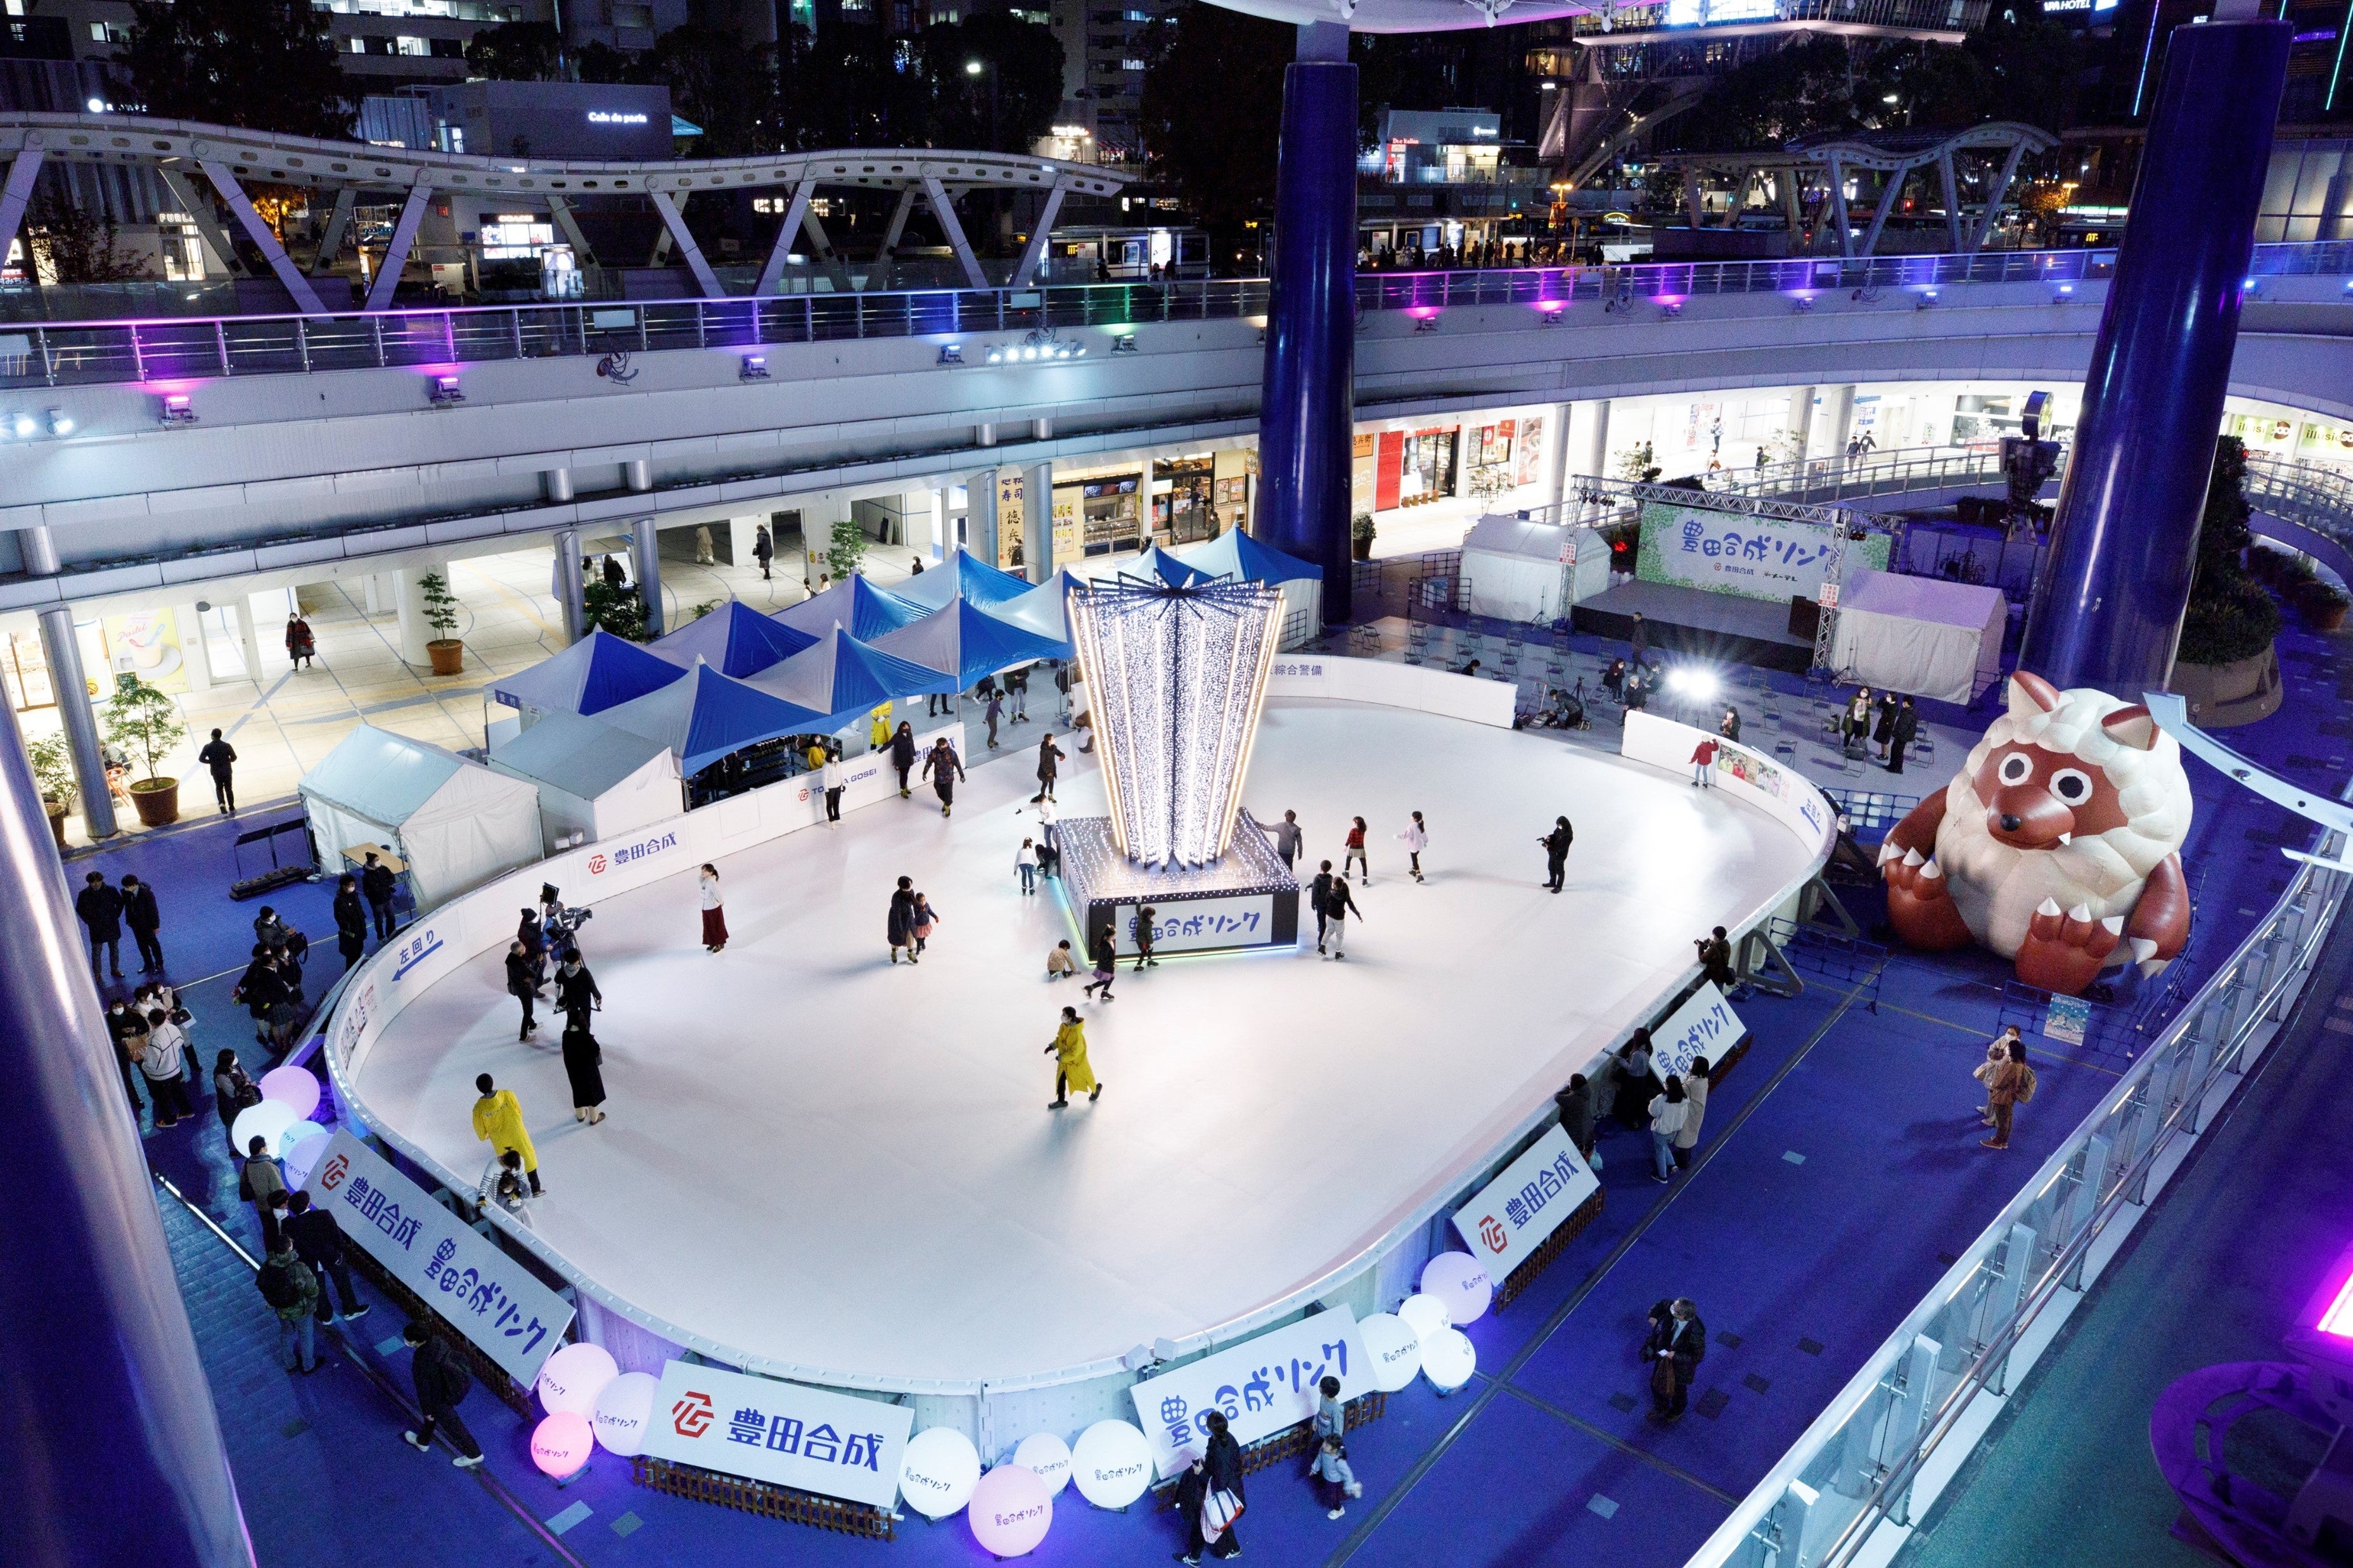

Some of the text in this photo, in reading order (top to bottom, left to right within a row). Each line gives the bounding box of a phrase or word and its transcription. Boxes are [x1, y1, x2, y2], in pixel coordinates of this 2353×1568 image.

[2060, 0, 2091, 10] HOTEL
[159, 213, 195, 222] FURLA
[1724, 565, 1754, 575] 豊田合成
[1270, 664, 1323, 677] 綜合警備
[851, 768, 877, 782] GOSEI
[613, 831, 677, 866] 豊田合成
[399, 929, 435, 965] 左回り
[1505, 1151, 1579, 1230] 豊田合成
[343, 1176, 423, 1251] 豊田合成
[424, 1237, 547, 1355] 豊田合成リンク
[1161, 1339, 1347, 1448] 豊田合成リンク
[727, 1407, 884, 1472] 豊田合成
[906, 1467, 951, 1491] 豊田合成リンク
[1094, 1463, 1142, 1481] 豊田合成リンク
[995, 1505, 1043, 1526] 豊田合成リンク
